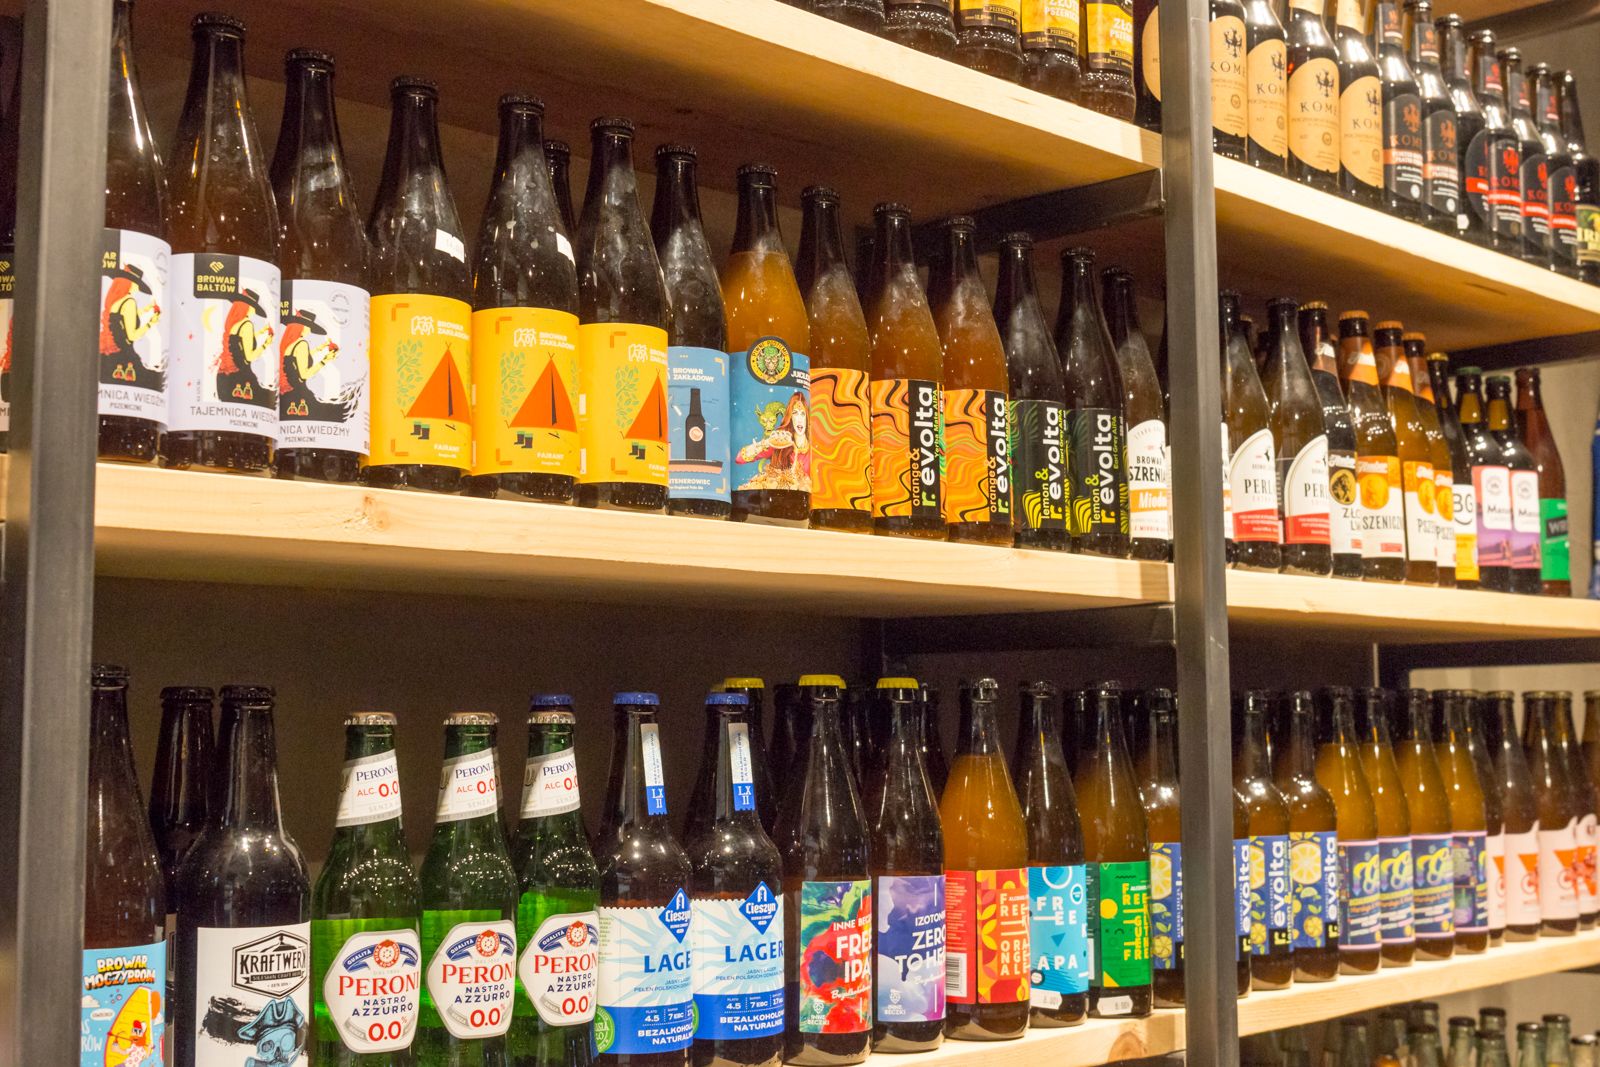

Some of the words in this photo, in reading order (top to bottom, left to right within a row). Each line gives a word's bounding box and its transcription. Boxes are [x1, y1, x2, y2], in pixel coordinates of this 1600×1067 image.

[1256, 83, 1287, 96] KOM
[1352, 118, 1383, 131] KOM
[1390, 136, 1423, 149] KOM
[1427, 150, 1457, 162] KOM
[1490, 176, 1520, 189] KOM
[197, 275, 237, 286] BROWAR
[197, 284, 237, 294] BALTÓW
[672, 367, 704, 376] BROWAR
[98, 388, 137, 404] MNICA
[190, 405, 247, 420] TAJEMNICA
[307, 424, 351, 439] WIEDŹMY
[914, 386, 937, 487] evolta
[990, 397, 1009, 495] evolta
[1042, 406, 1062, 501] evolta
[906, 448, 921, 462] &
[984, 456, 996, 469] &
[1093, 413, 1114, 506] evolta
[1035, 467, 1049, 481] &
[1085, 473, 1100, 487] &
[910, 463, 922, 507] orange
[988, 469, 999, 513] orange
[1041, 482, 1050, 520] lemon
[1091, 487, 1101, 525] lemon
[1139, 491, 1167, 508] Miod
[737, 785, 752, 797] LX
[1269, 841, 1285, 927] evolta
[1324, 837, 1337, 920] evolta
[1239, 845, 1251, 933] evolta
[744, 902, 777, 919] Cieszyn
[833, 919, 856, 931] INNE
[548, 929, 574, 947] QUALITÀ
[449, 938, 475, 957] QUALITÀ
[725, 940, 785, 964] LAGER
[97, 954, 150, 974] BROWAR
[346, 948, 373, 967] QUALITÀ
[534, 948, 598, 974] PERON
[895, 953, 923, 973] TO
[1037, 954, 1078, 971] APA
[844, 956, 871, 983] IPA
[338, 971, 420, 996] PERONI
[545, 979, 597, 993] AZZURRO
[556, 973, 592, 984] NASTRO
[454, 990, 510, 1004] AZZURRO
[466, 983, 505, 995] NASTRO
[363, 995, 406, 1006] NASTRO
[351, 1003, 413, 1018] AZZURRO
